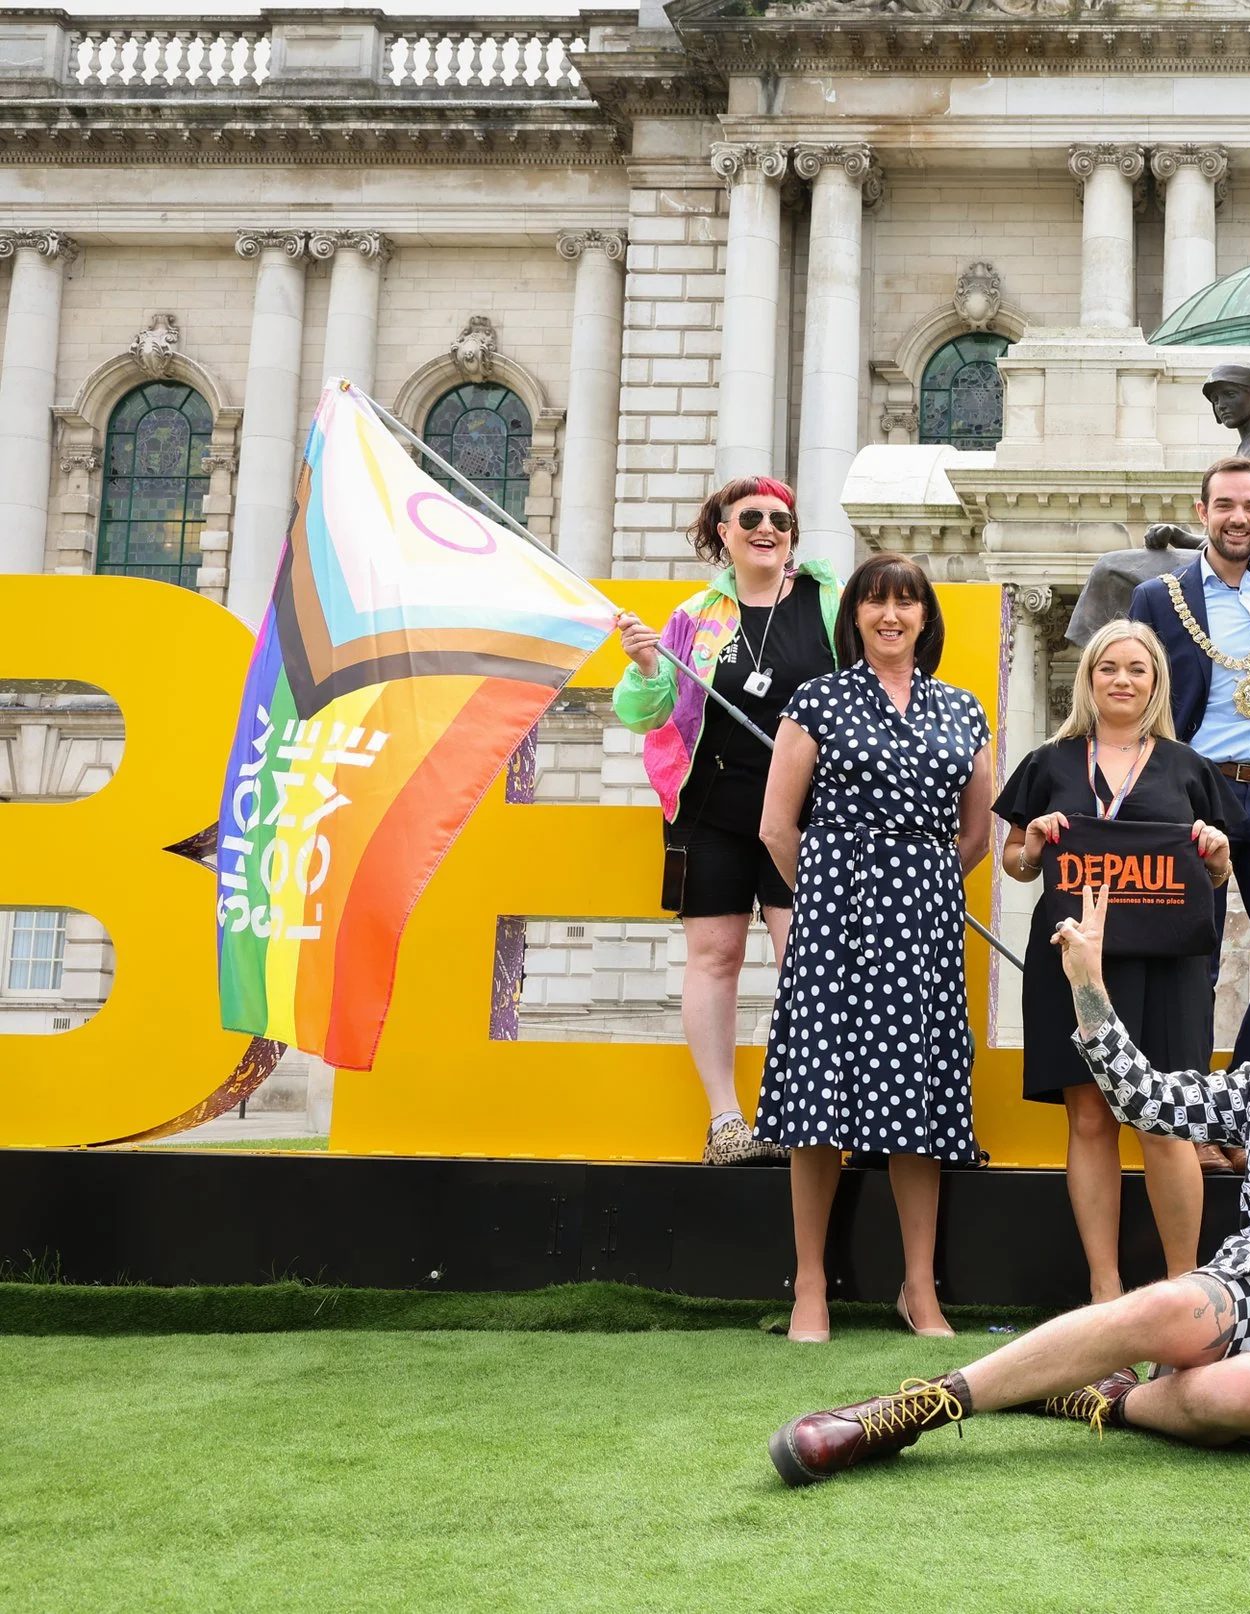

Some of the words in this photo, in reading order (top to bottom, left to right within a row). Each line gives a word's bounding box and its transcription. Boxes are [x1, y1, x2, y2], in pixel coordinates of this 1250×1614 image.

[285, 719, 391, 940] LOVE
[1056, 851, 1185, 891] DEPAUL
[1166, 897, 1185, 905] place
